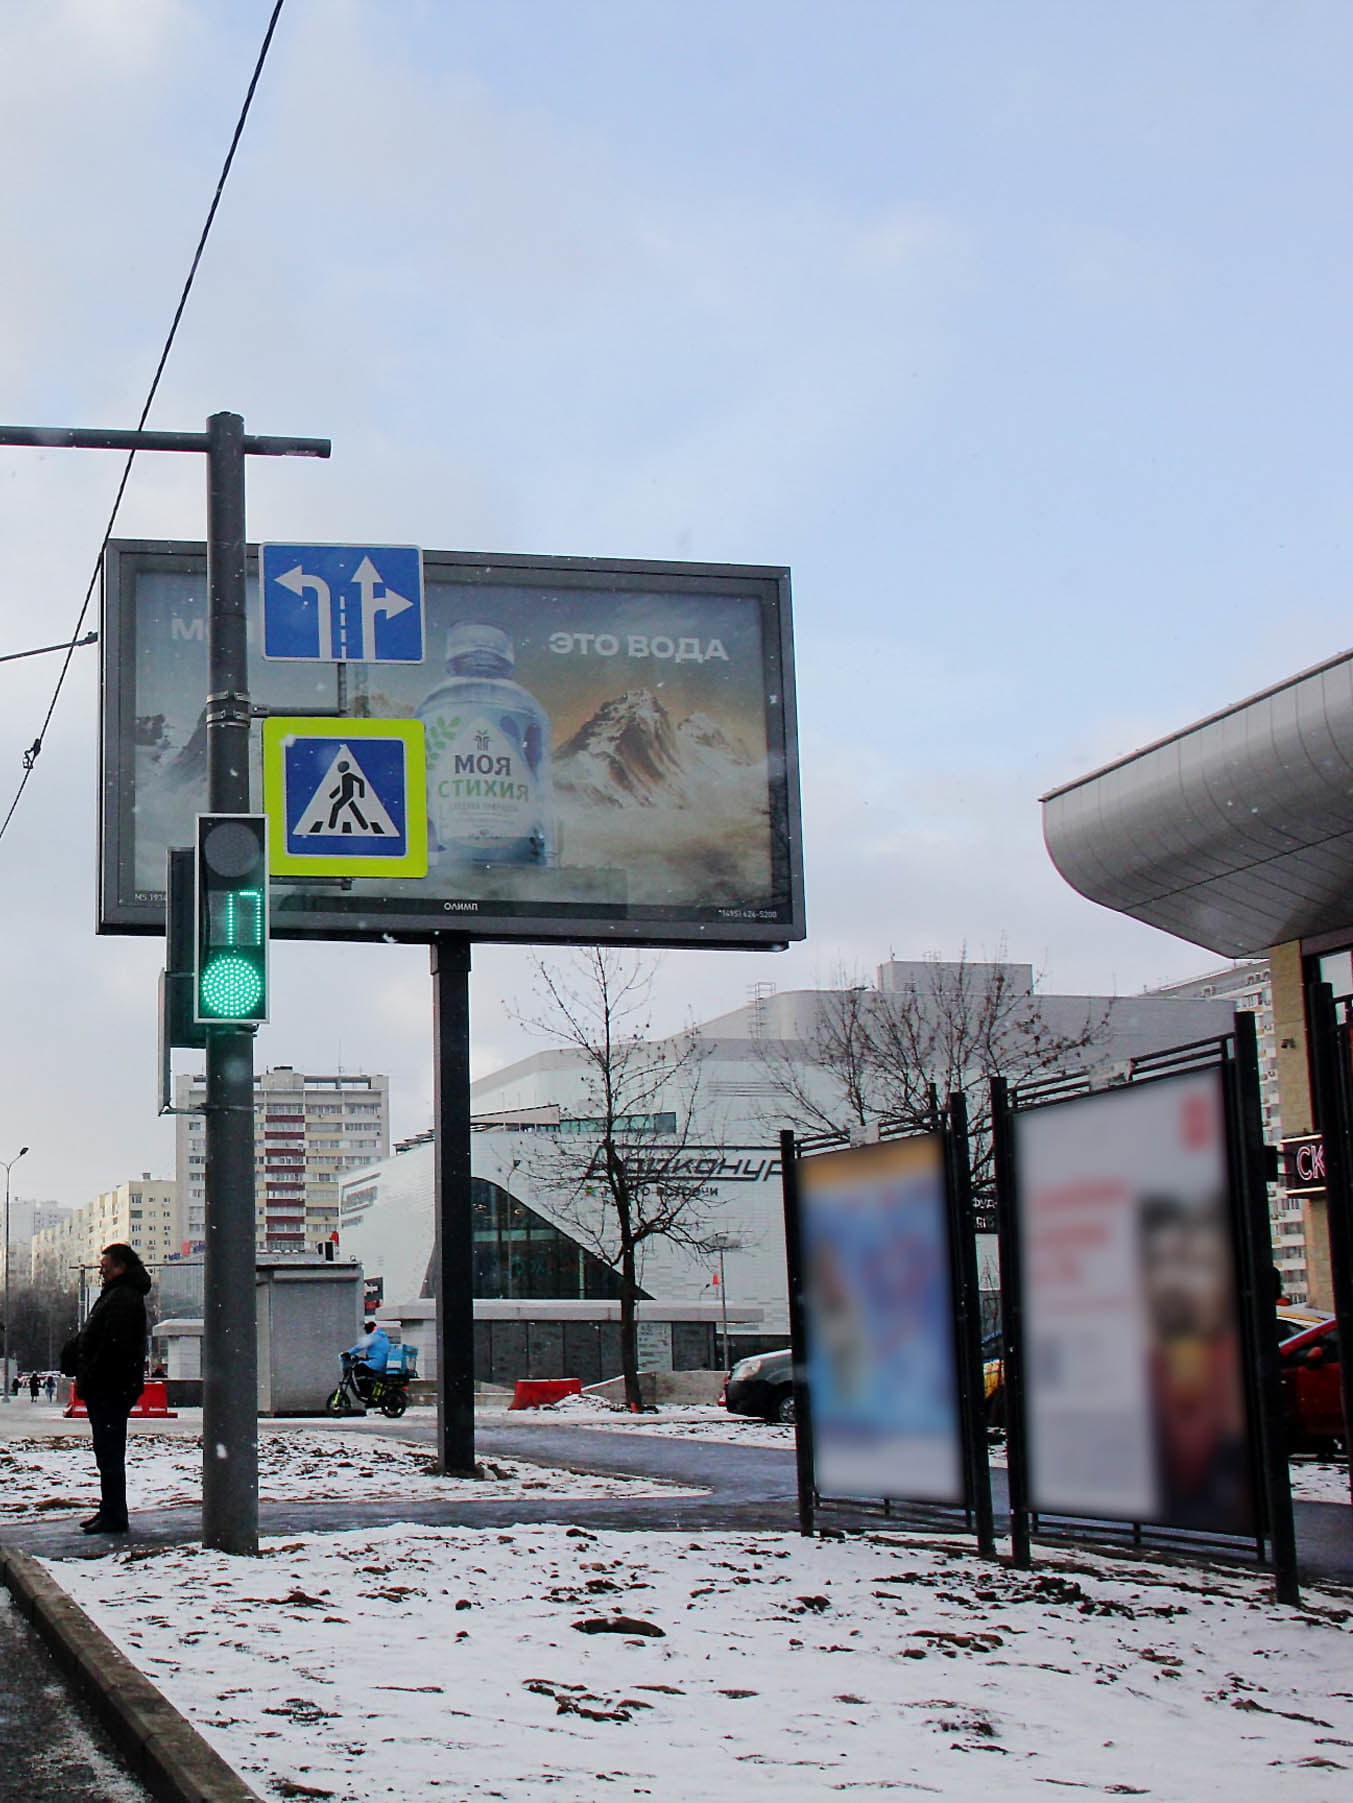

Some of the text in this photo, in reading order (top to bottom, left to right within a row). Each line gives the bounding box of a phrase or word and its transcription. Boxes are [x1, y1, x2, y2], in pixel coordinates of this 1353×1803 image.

[549, 631, 729, 664] ЭТО ВОДА
[454, 754, 511, 776] МОЯ
[438, 779, 529, 802] СТИХИЯ
[443, 902, 479, 911] ОЛИМП
